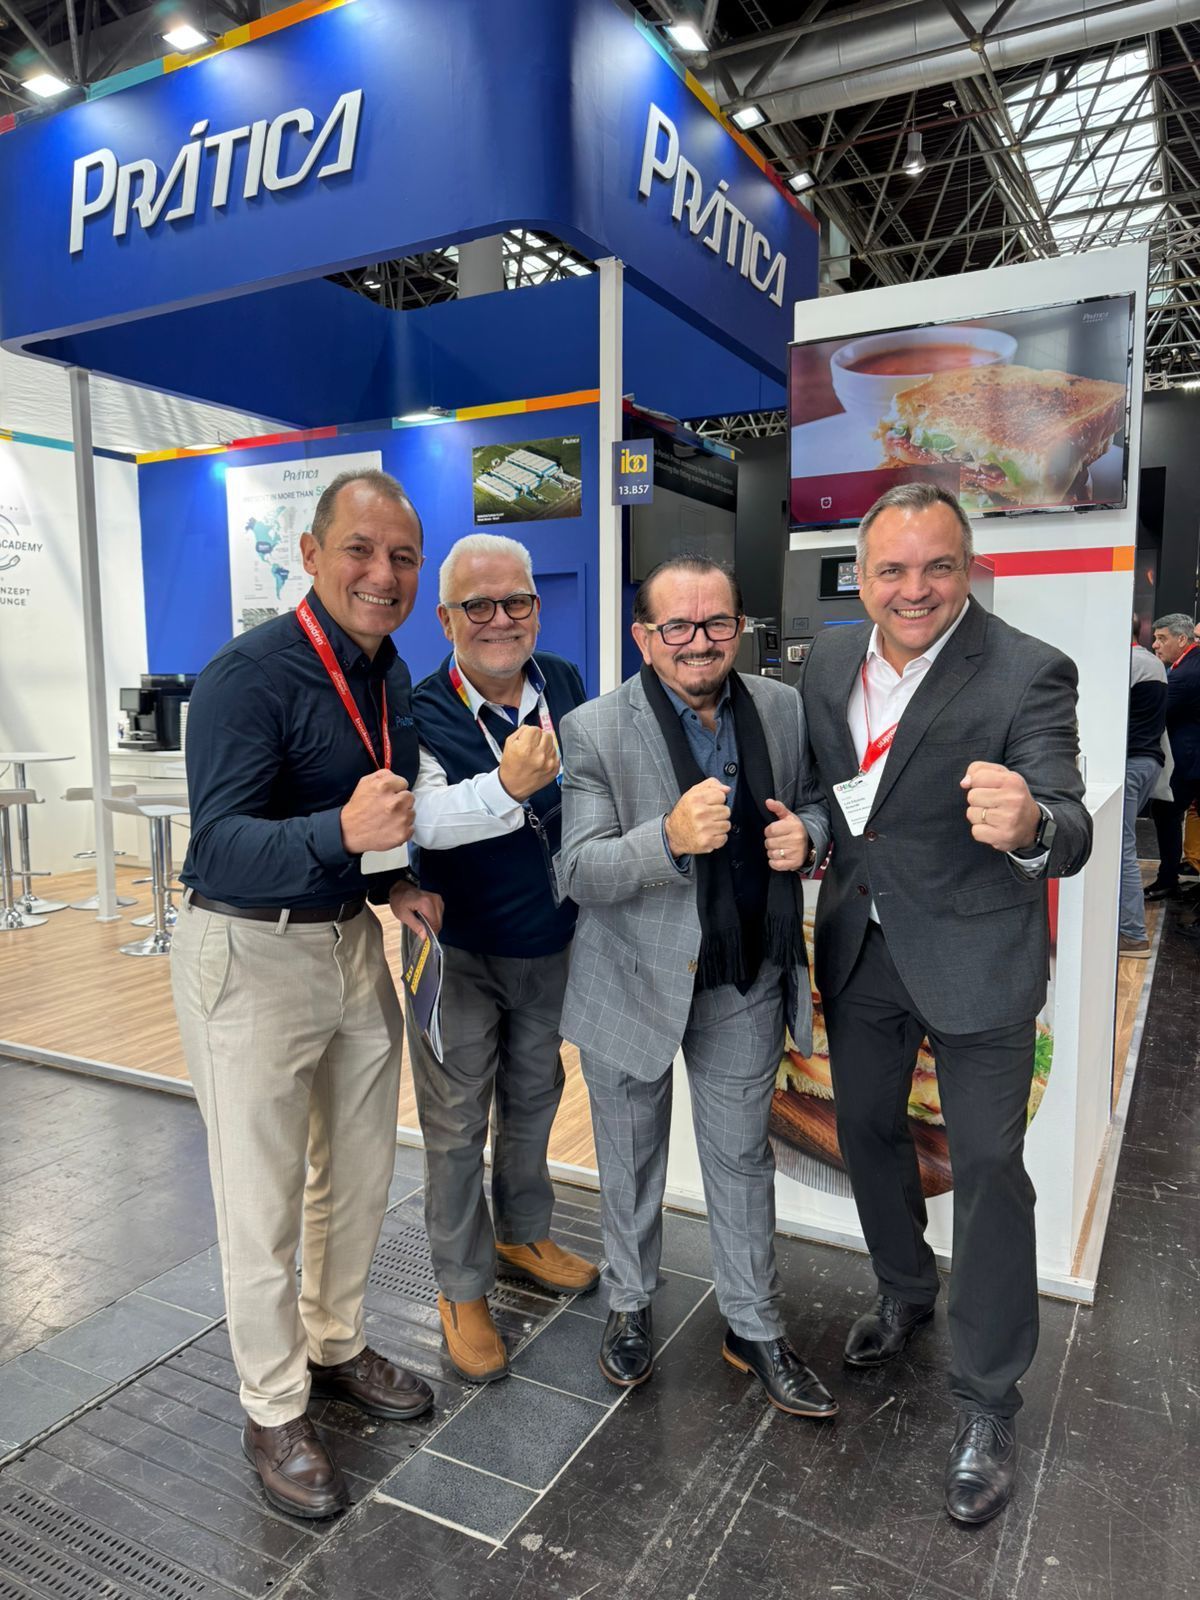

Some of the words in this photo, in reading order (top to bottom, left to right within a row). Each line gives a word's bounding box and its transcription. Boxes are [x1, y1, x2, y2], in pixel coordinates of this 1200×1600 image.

[69, 88, 362, 254] PRÁTICA
[638, 102, 787, 308] PRÁTICA
[621, 448, 647, 473] iba
[278, 491, 296, 500] MORE
[296, 489, 314, 498] THAN
[618, 484, 650, 495] 13.B57
[0, 539, 43, 552] CADEMY
[0, 586, 31, 596] NZEPT
[877, 729, 897, 748] aldrin
